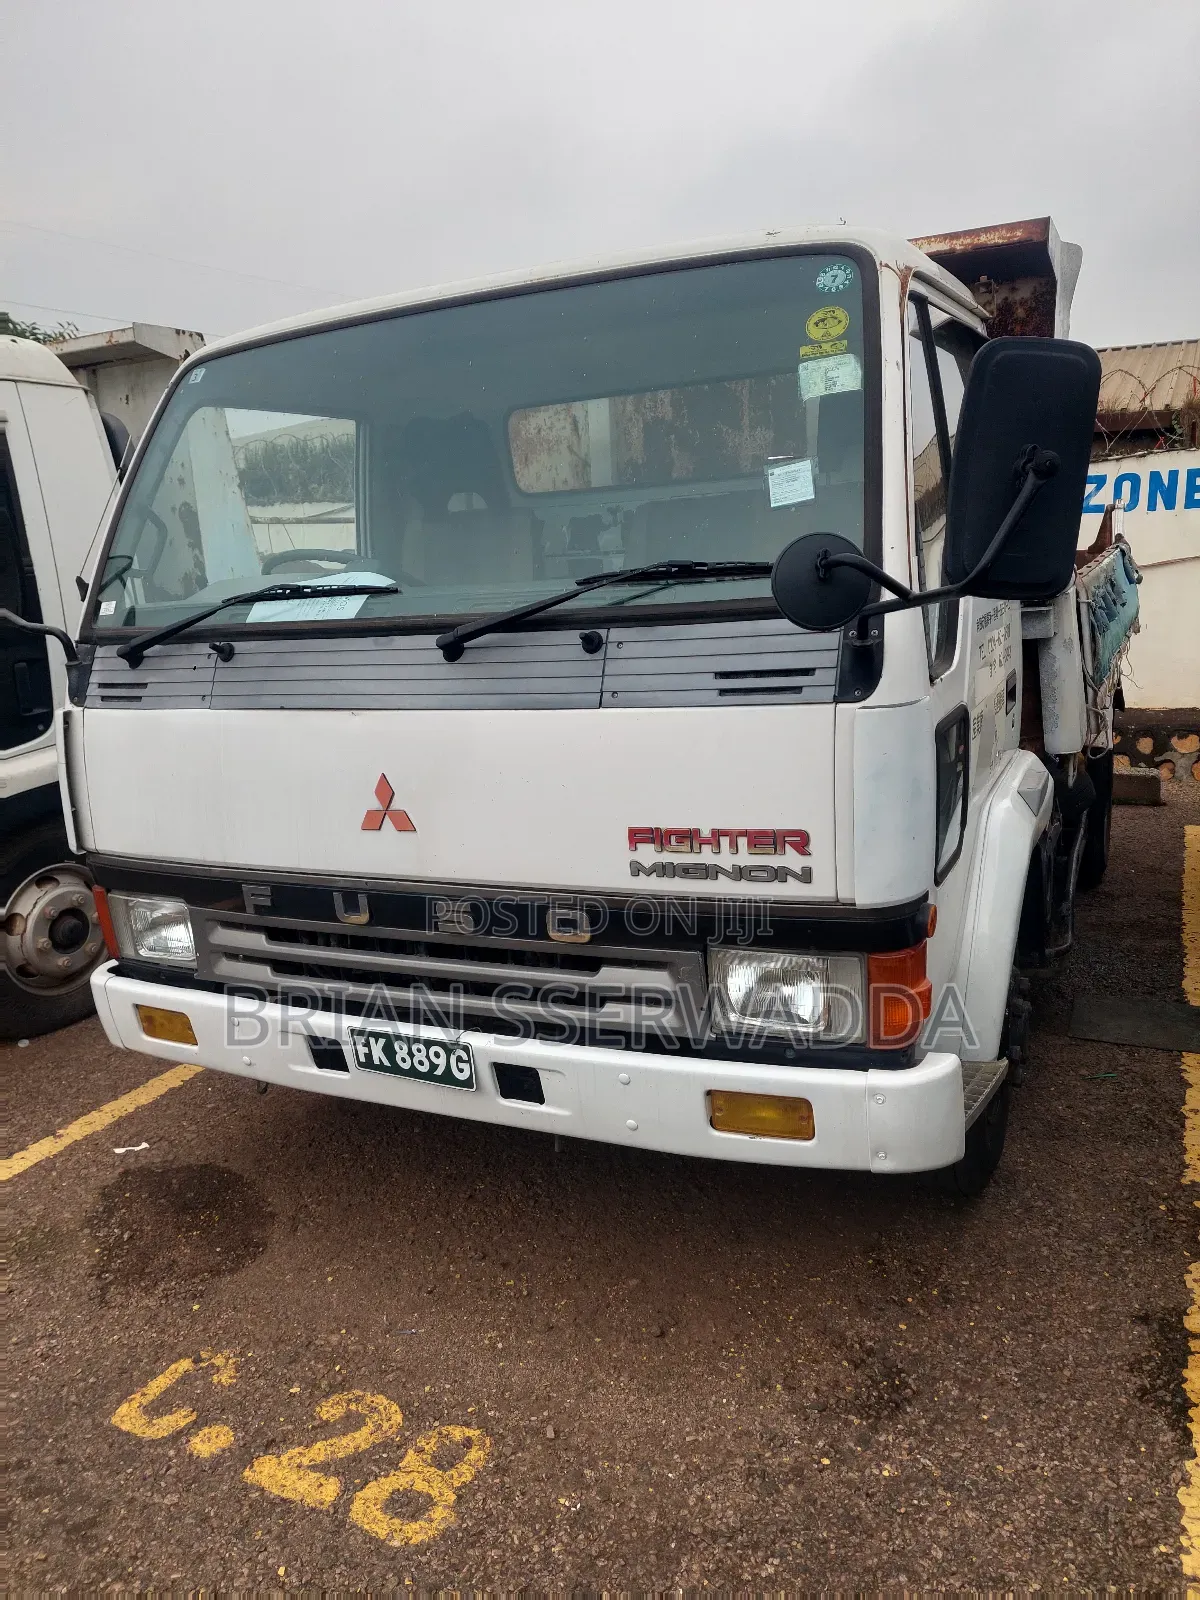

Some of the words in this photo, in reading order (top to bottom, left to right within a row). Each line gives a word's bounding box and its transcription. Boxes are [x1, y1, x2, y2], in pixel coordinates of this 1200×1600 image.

[1082, 467, 1200, 514] ZONE
[628, 827, 811, 856] FIGHTER
[630, 859, 812, 884] MIGNON
[241, 883, 592, 944] FUSO
[353, 1035, 391, 1067] FK
[393, 1040, 471, 1081] 889G
